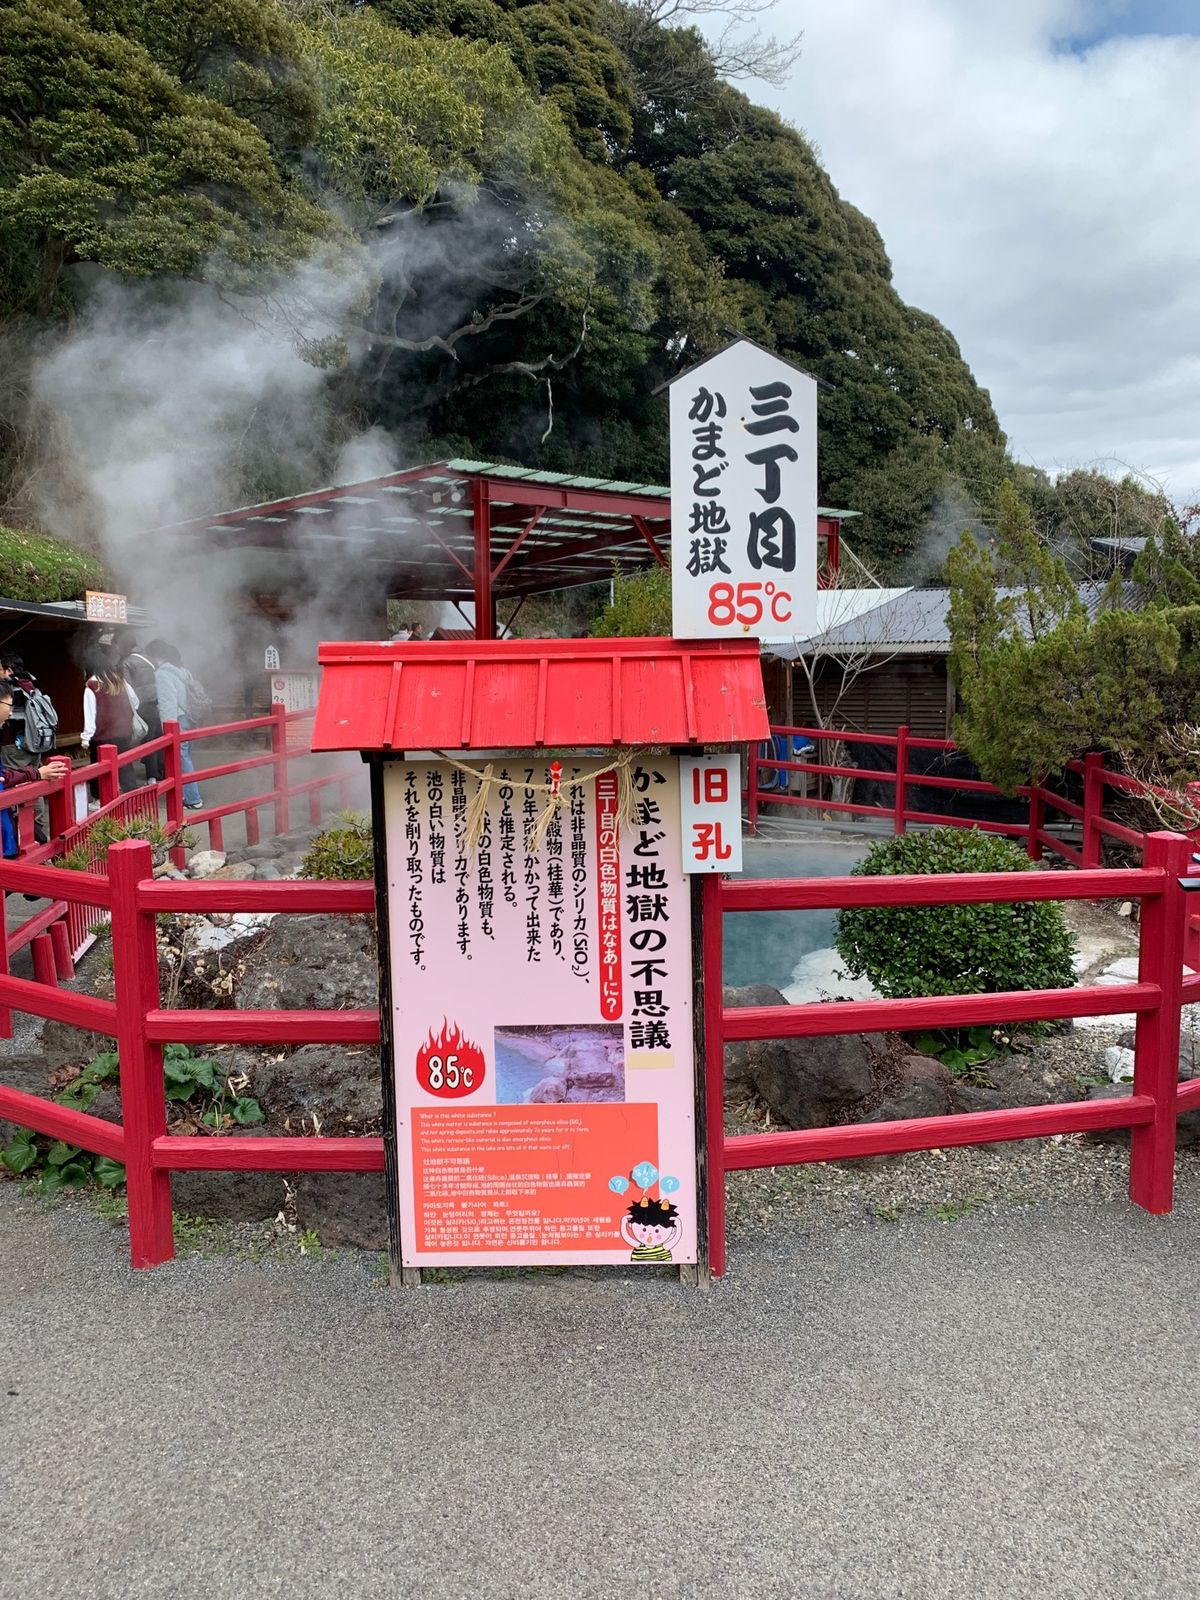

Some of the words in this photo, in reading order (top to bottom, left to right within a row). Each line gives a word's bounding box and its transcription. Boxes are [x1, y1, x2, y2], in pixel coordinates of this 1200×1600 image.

[686, 386, 732, 577] かまど地獄
[743, 381, 800, 573] 三丁目
[404, 771, 426, 971] それを削り取ったものです。
[427, 770, 446, 885] 池の白い物質は
[625, 766, 672, 1050] かまど地獄の不思議
[692, 767, 731, 860] 旧孔
